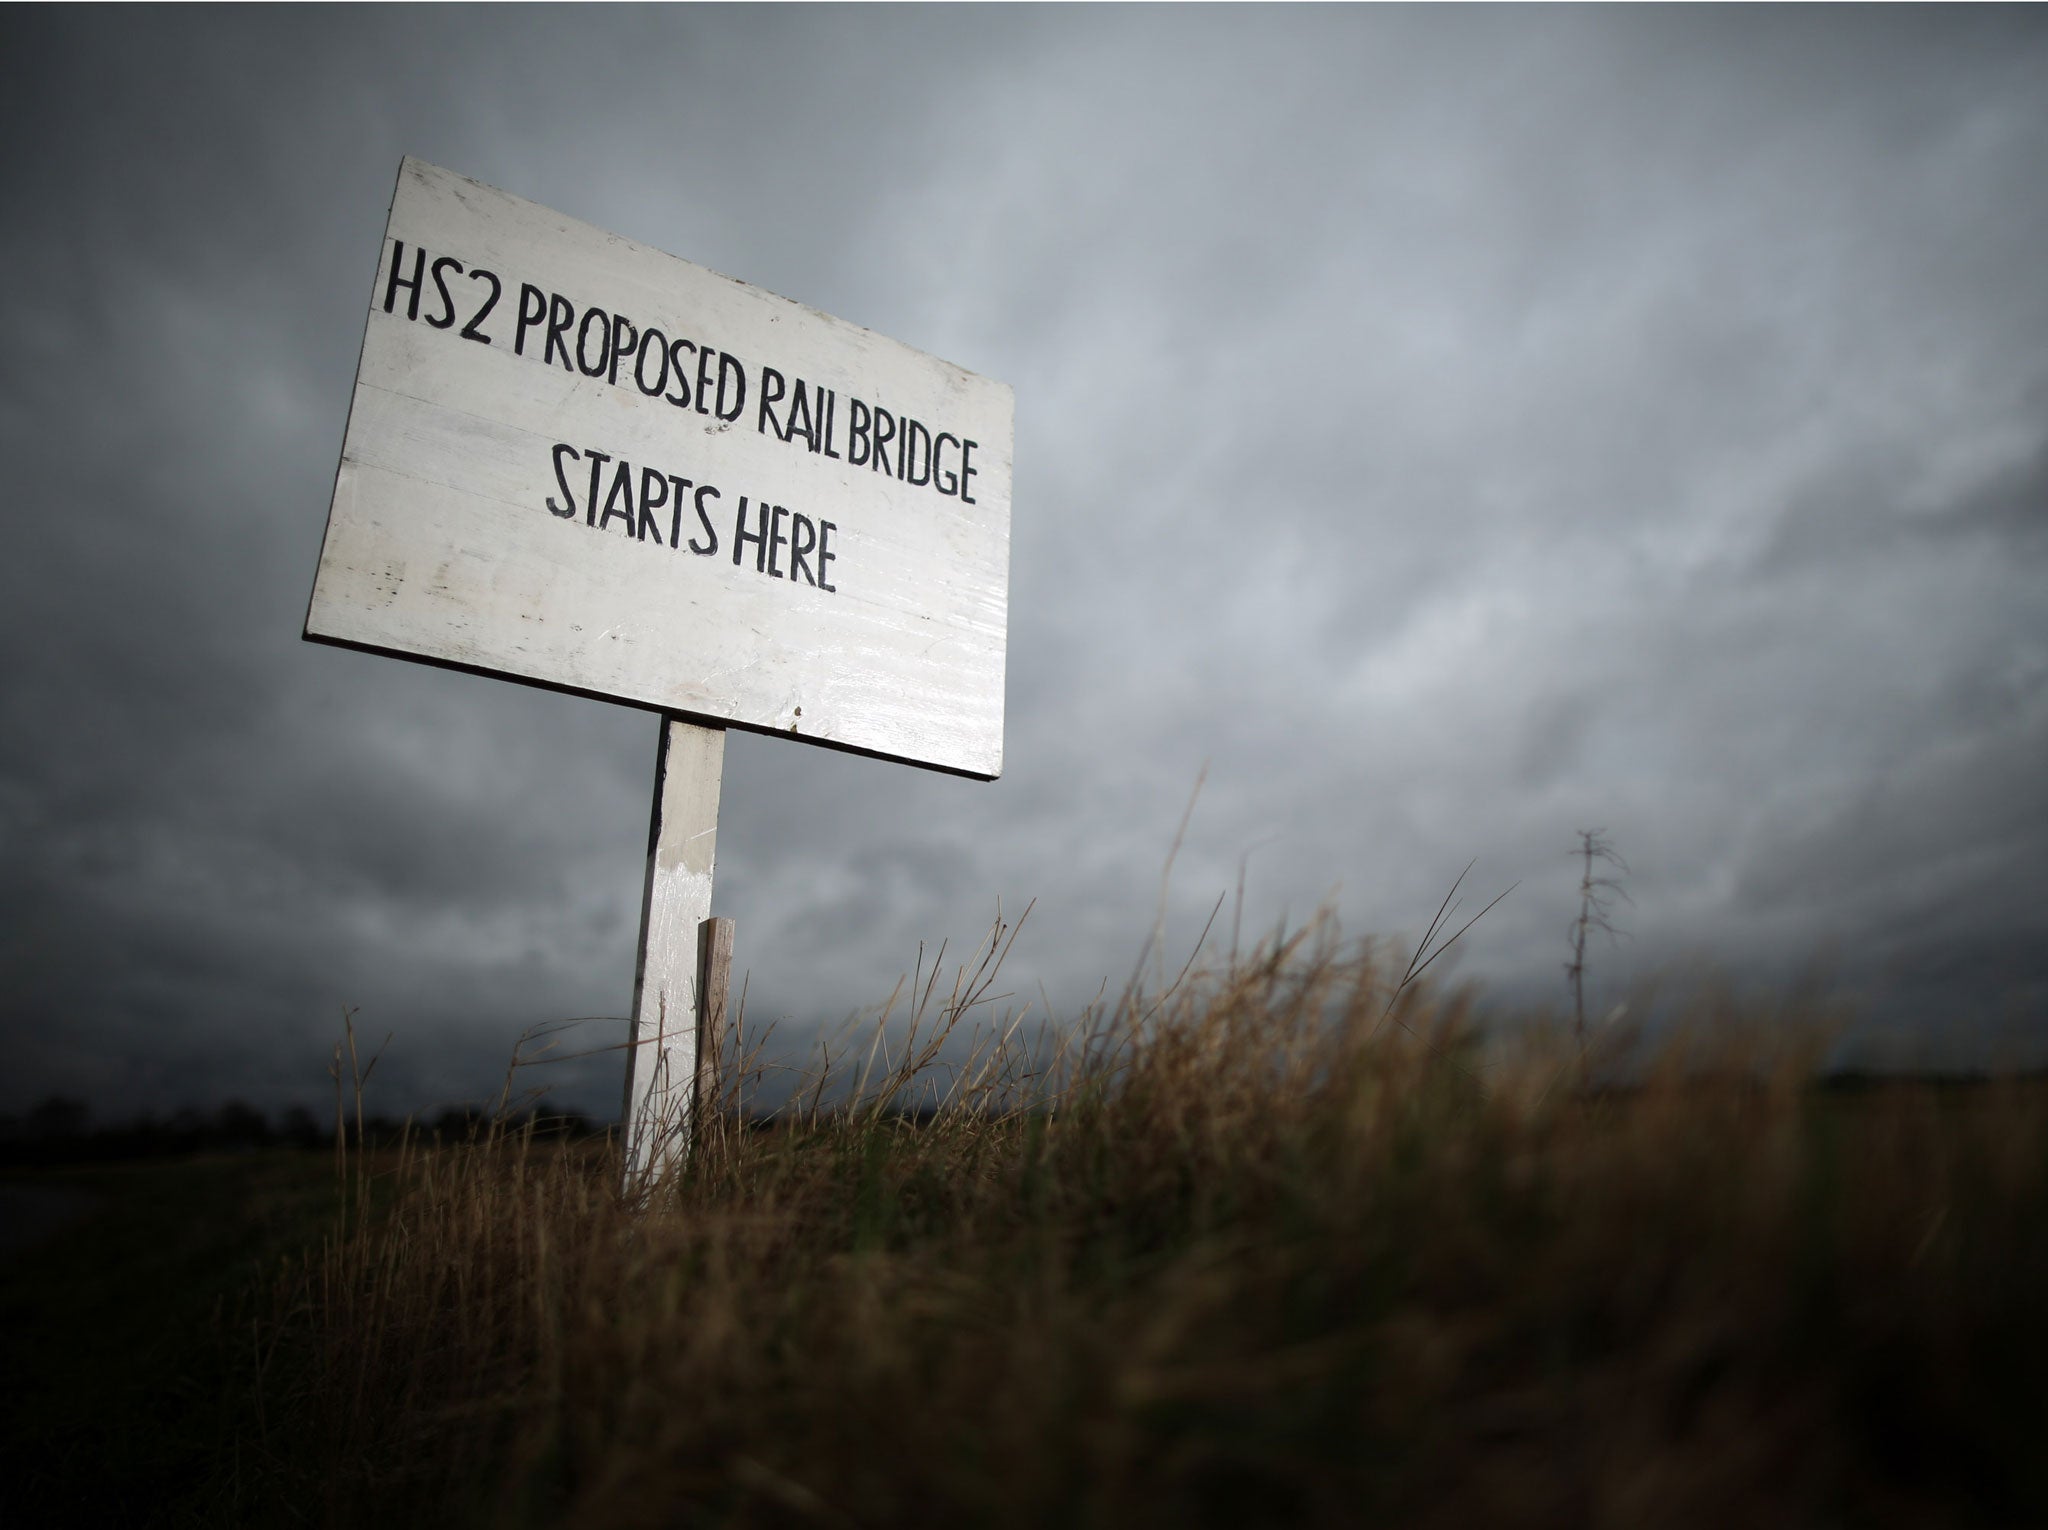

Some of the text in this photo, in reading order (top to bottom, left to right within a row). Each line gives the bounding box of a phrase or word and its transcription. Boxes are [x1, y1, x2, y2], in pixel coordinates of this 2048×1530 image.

[383, 240, 978, 505] HS2 PROPOSED RAIL BRIDGE
[545, 443, 838, 594] STARTS HERE
